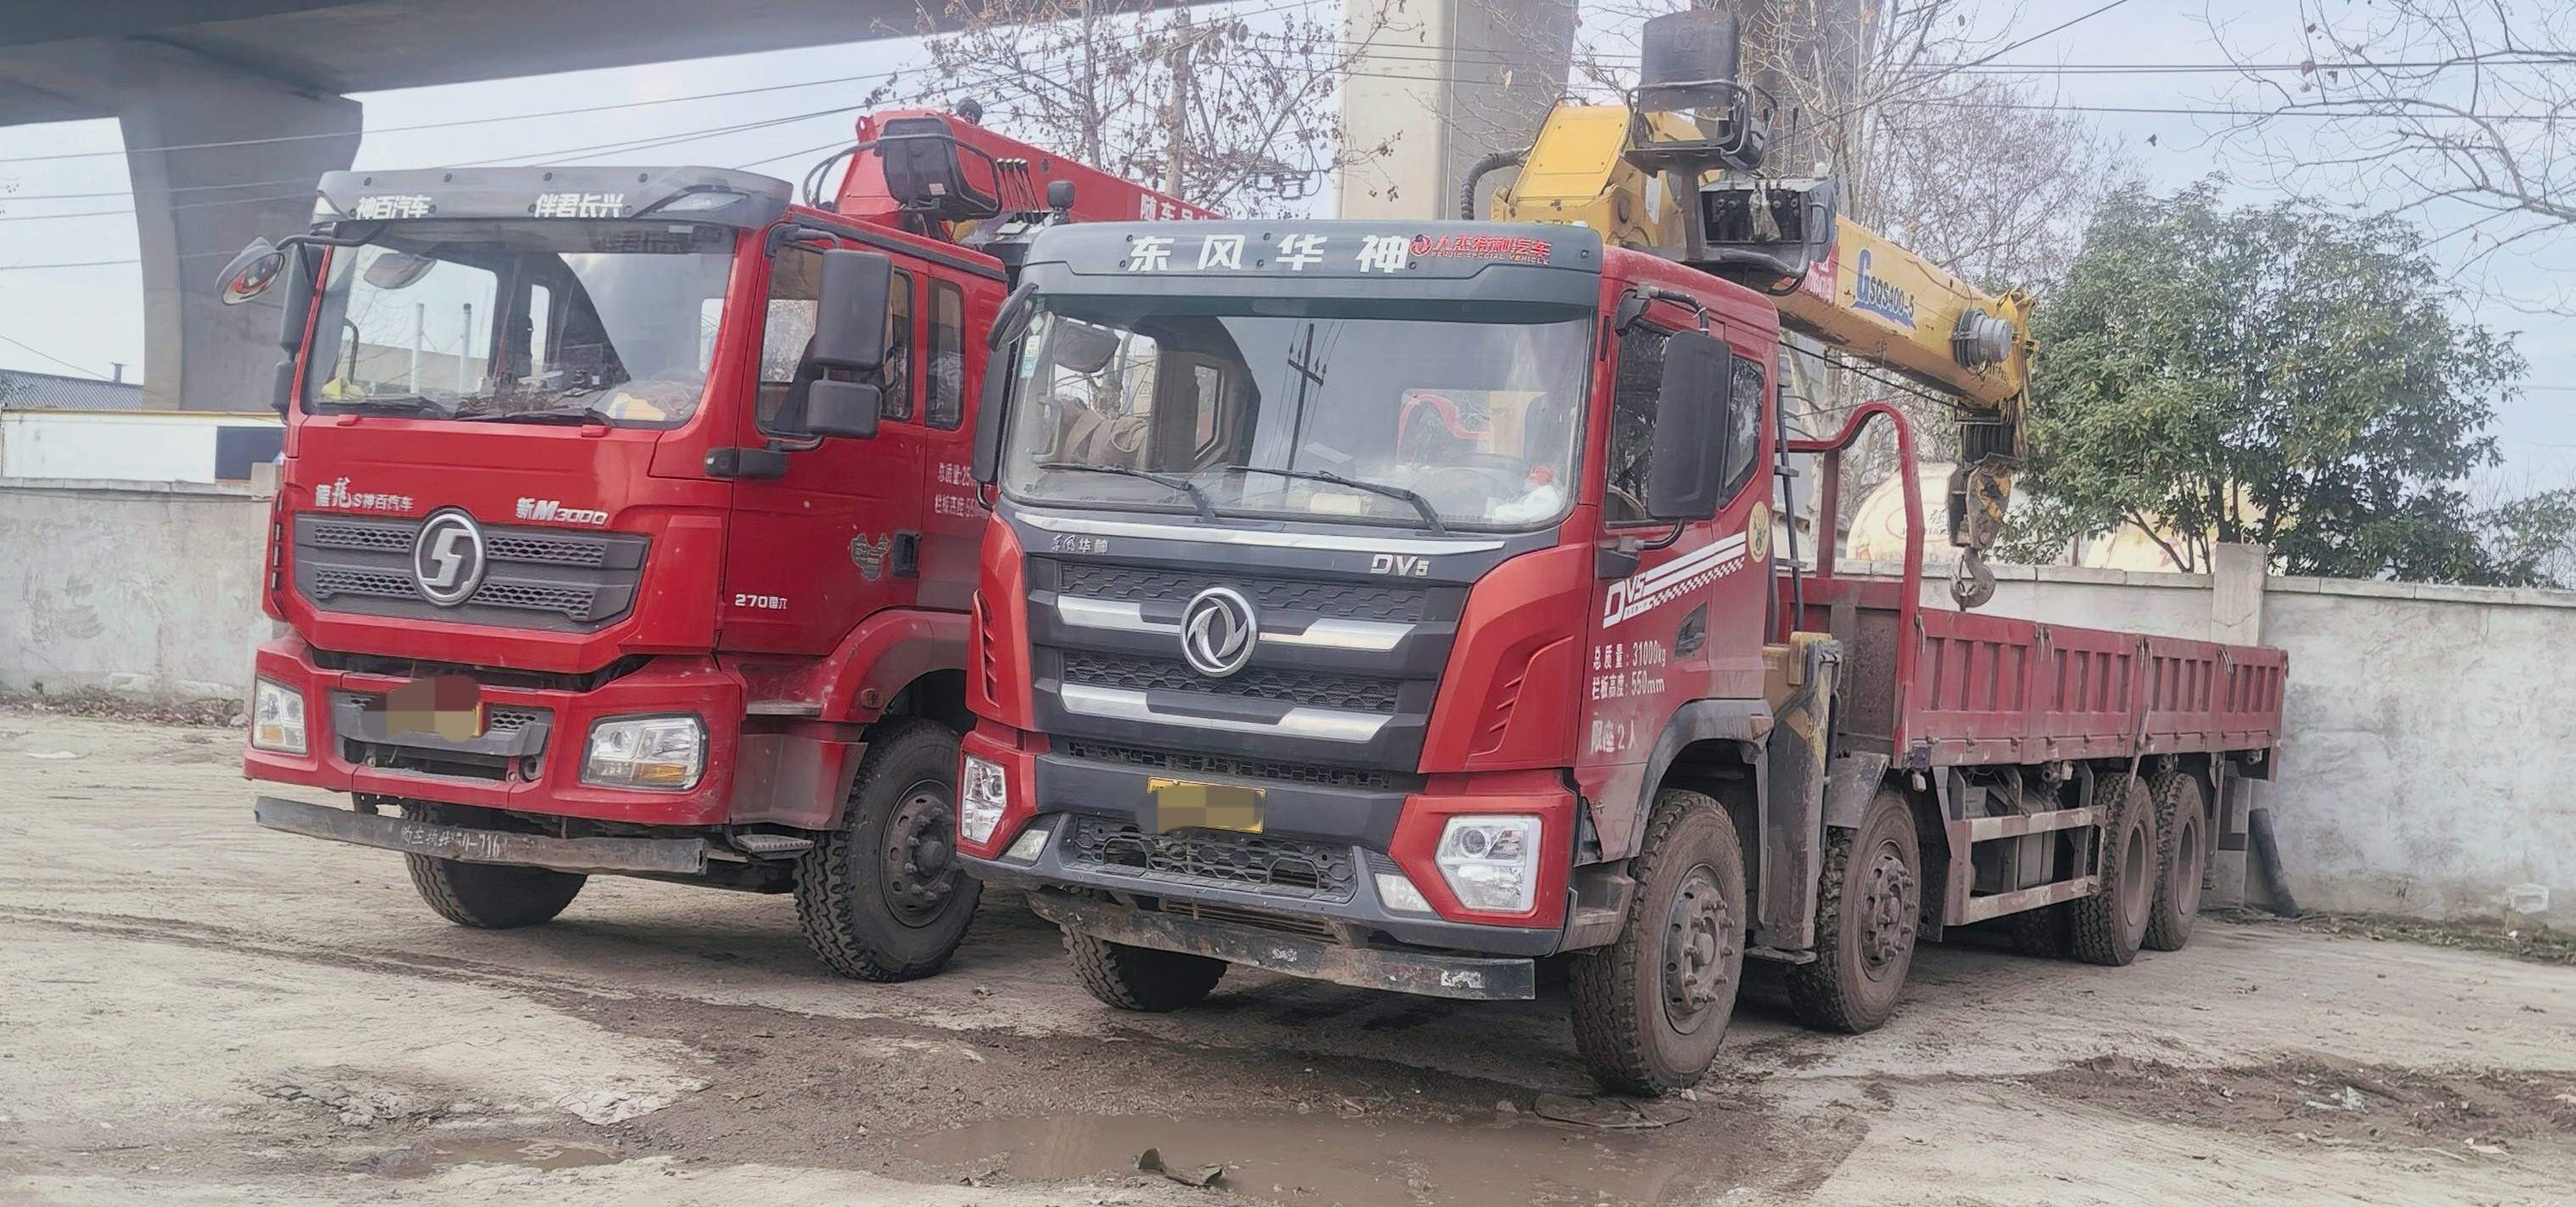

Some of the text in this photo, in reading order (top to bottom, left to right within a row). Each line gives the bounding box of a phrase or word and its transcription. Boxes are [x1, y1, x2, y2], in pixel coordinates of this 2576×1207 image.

[355, 194, 432, 220] 神百汽车
[533, 192, 625, 219] 伴君长兴
[1127, 233, 1409, 274] 东风华神
[1370, 553, 1430, 576] DV5
